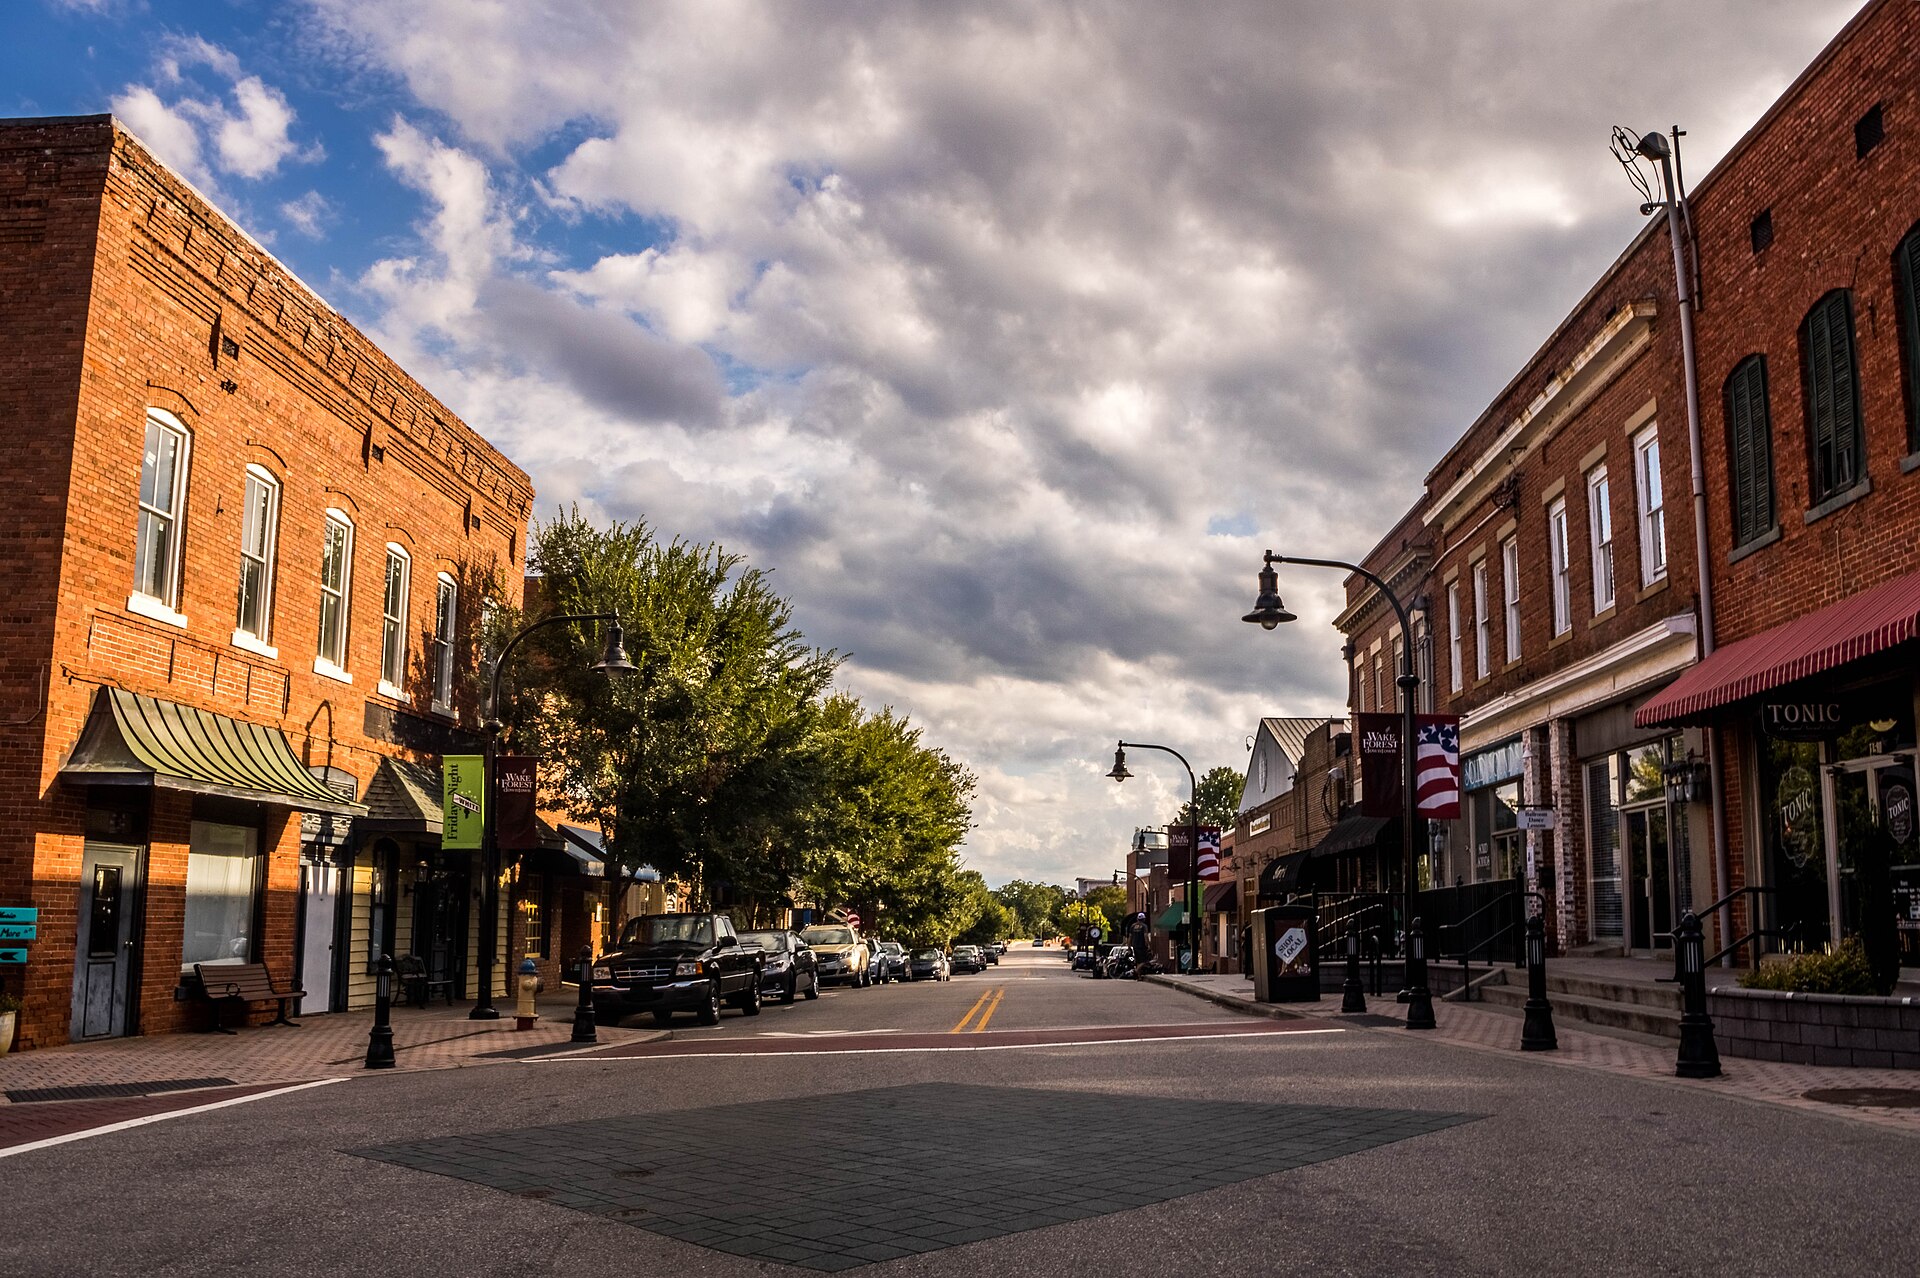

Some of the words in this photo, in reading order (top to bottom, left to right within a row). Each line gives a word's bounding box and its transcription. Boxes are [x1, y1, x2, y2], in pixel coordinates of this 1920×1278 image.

[1766, 704, 1841, 724] TONIC
[1363, 738, 1398, 749] FOREST
[1367, 731, 1396, 741] WAKE
[448, 764, 462, 796] Night
[501, 779, 533, 788] FOREST
[505, 773, 531, 782] WAKE
[459, 797, 479, 812] WHITE
[1781, 788, 1812, 826] TONIC
[1888, 797, 1909, 820] TONIC
[447, 804, 461, 840] Friday
[1278, 935, 1294, 953] SHOP
[1283, 938, 1303, 957] LOCAL
